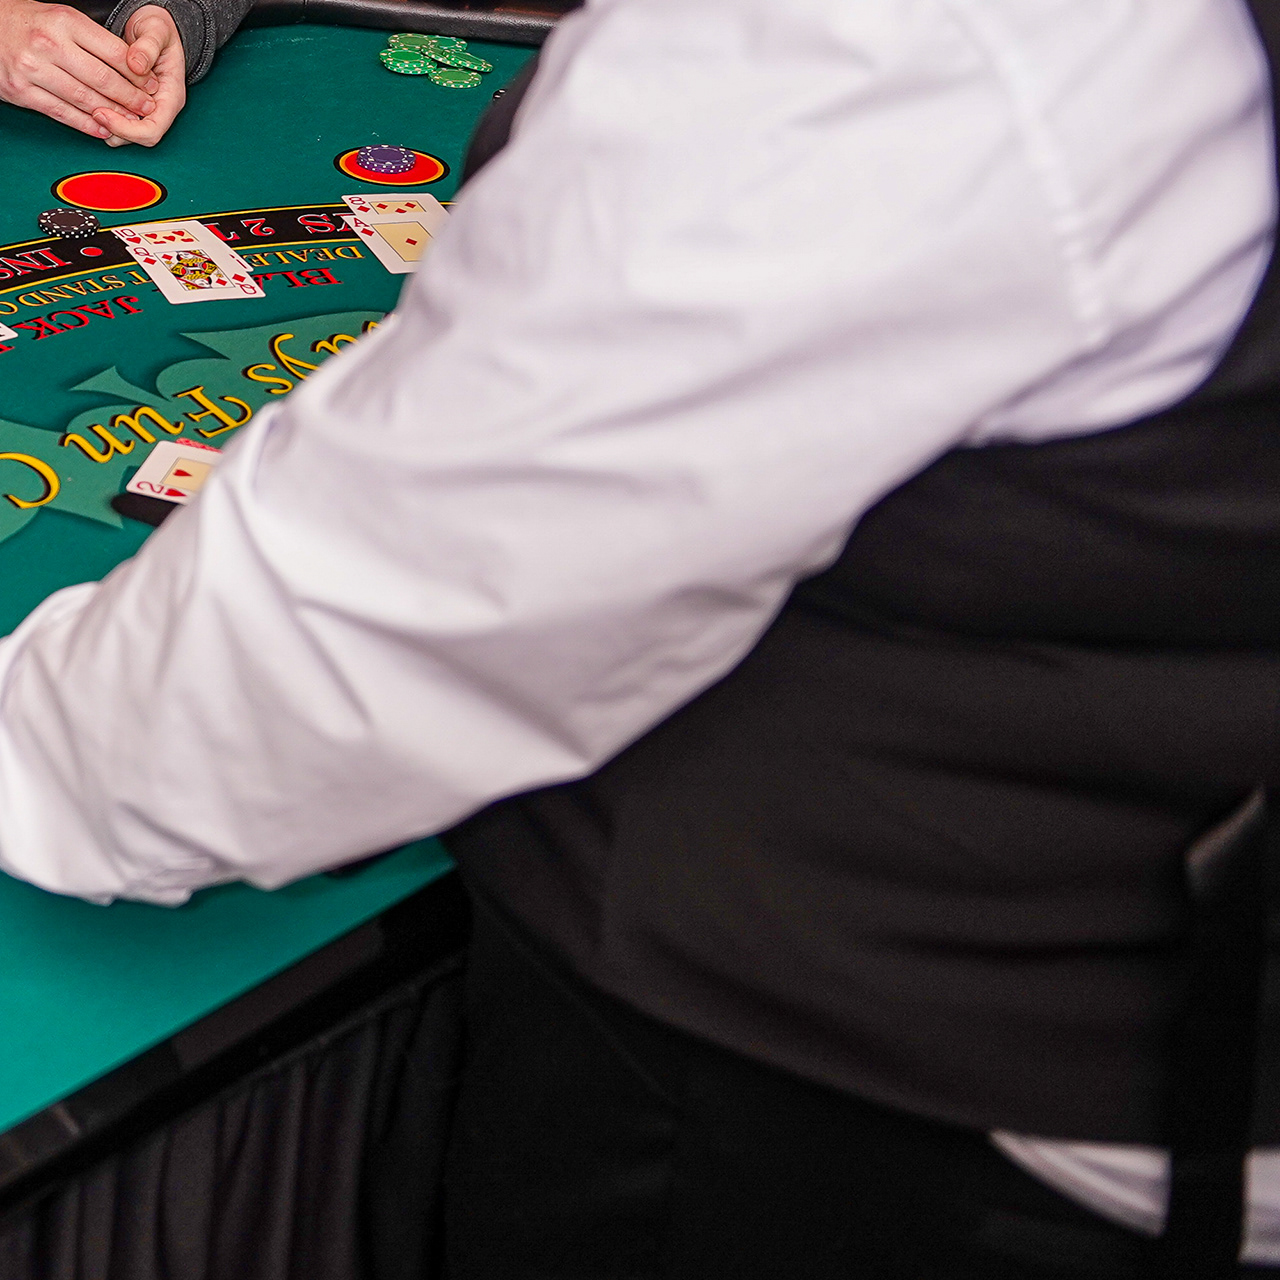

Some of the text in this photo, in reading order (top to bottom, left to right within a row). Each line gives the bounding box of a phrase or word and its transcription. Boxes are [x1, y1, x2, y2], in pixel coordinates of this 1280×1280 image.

[240, 218, 276, 237] 2
[240, 246, 366, 268] DEALE
[17, 275, 127, 308] STAND
[10, 295, 144, 341] JACK
[61, 386, 253, 464] Fun
